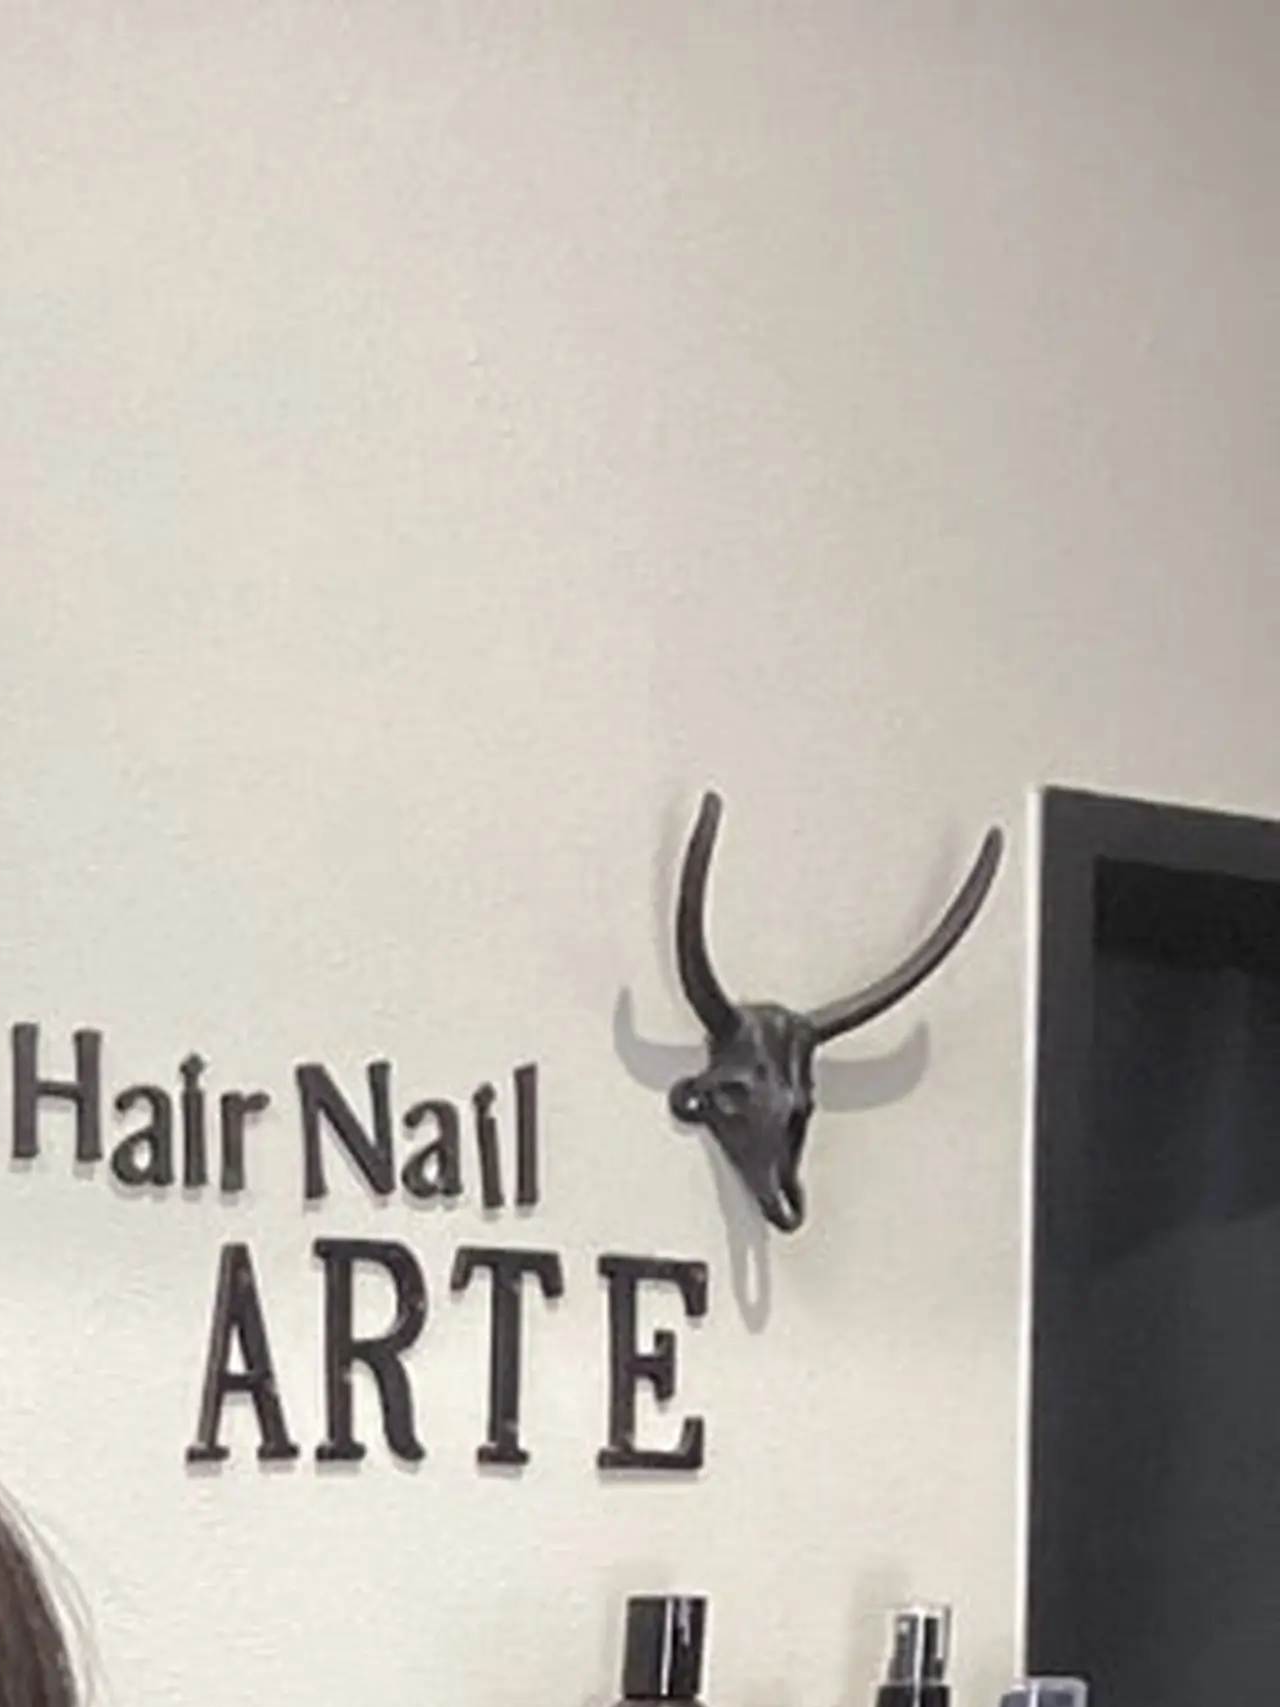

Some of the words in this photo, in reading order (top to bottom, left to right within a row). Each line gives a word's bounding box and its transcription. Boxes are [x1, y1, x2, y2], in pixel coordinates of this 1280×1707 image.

[11, 1022, 271, 1192] Hair
[295, 1059, 539, 1208] Nail
[185, 1237, 709, 1470] ARTE
